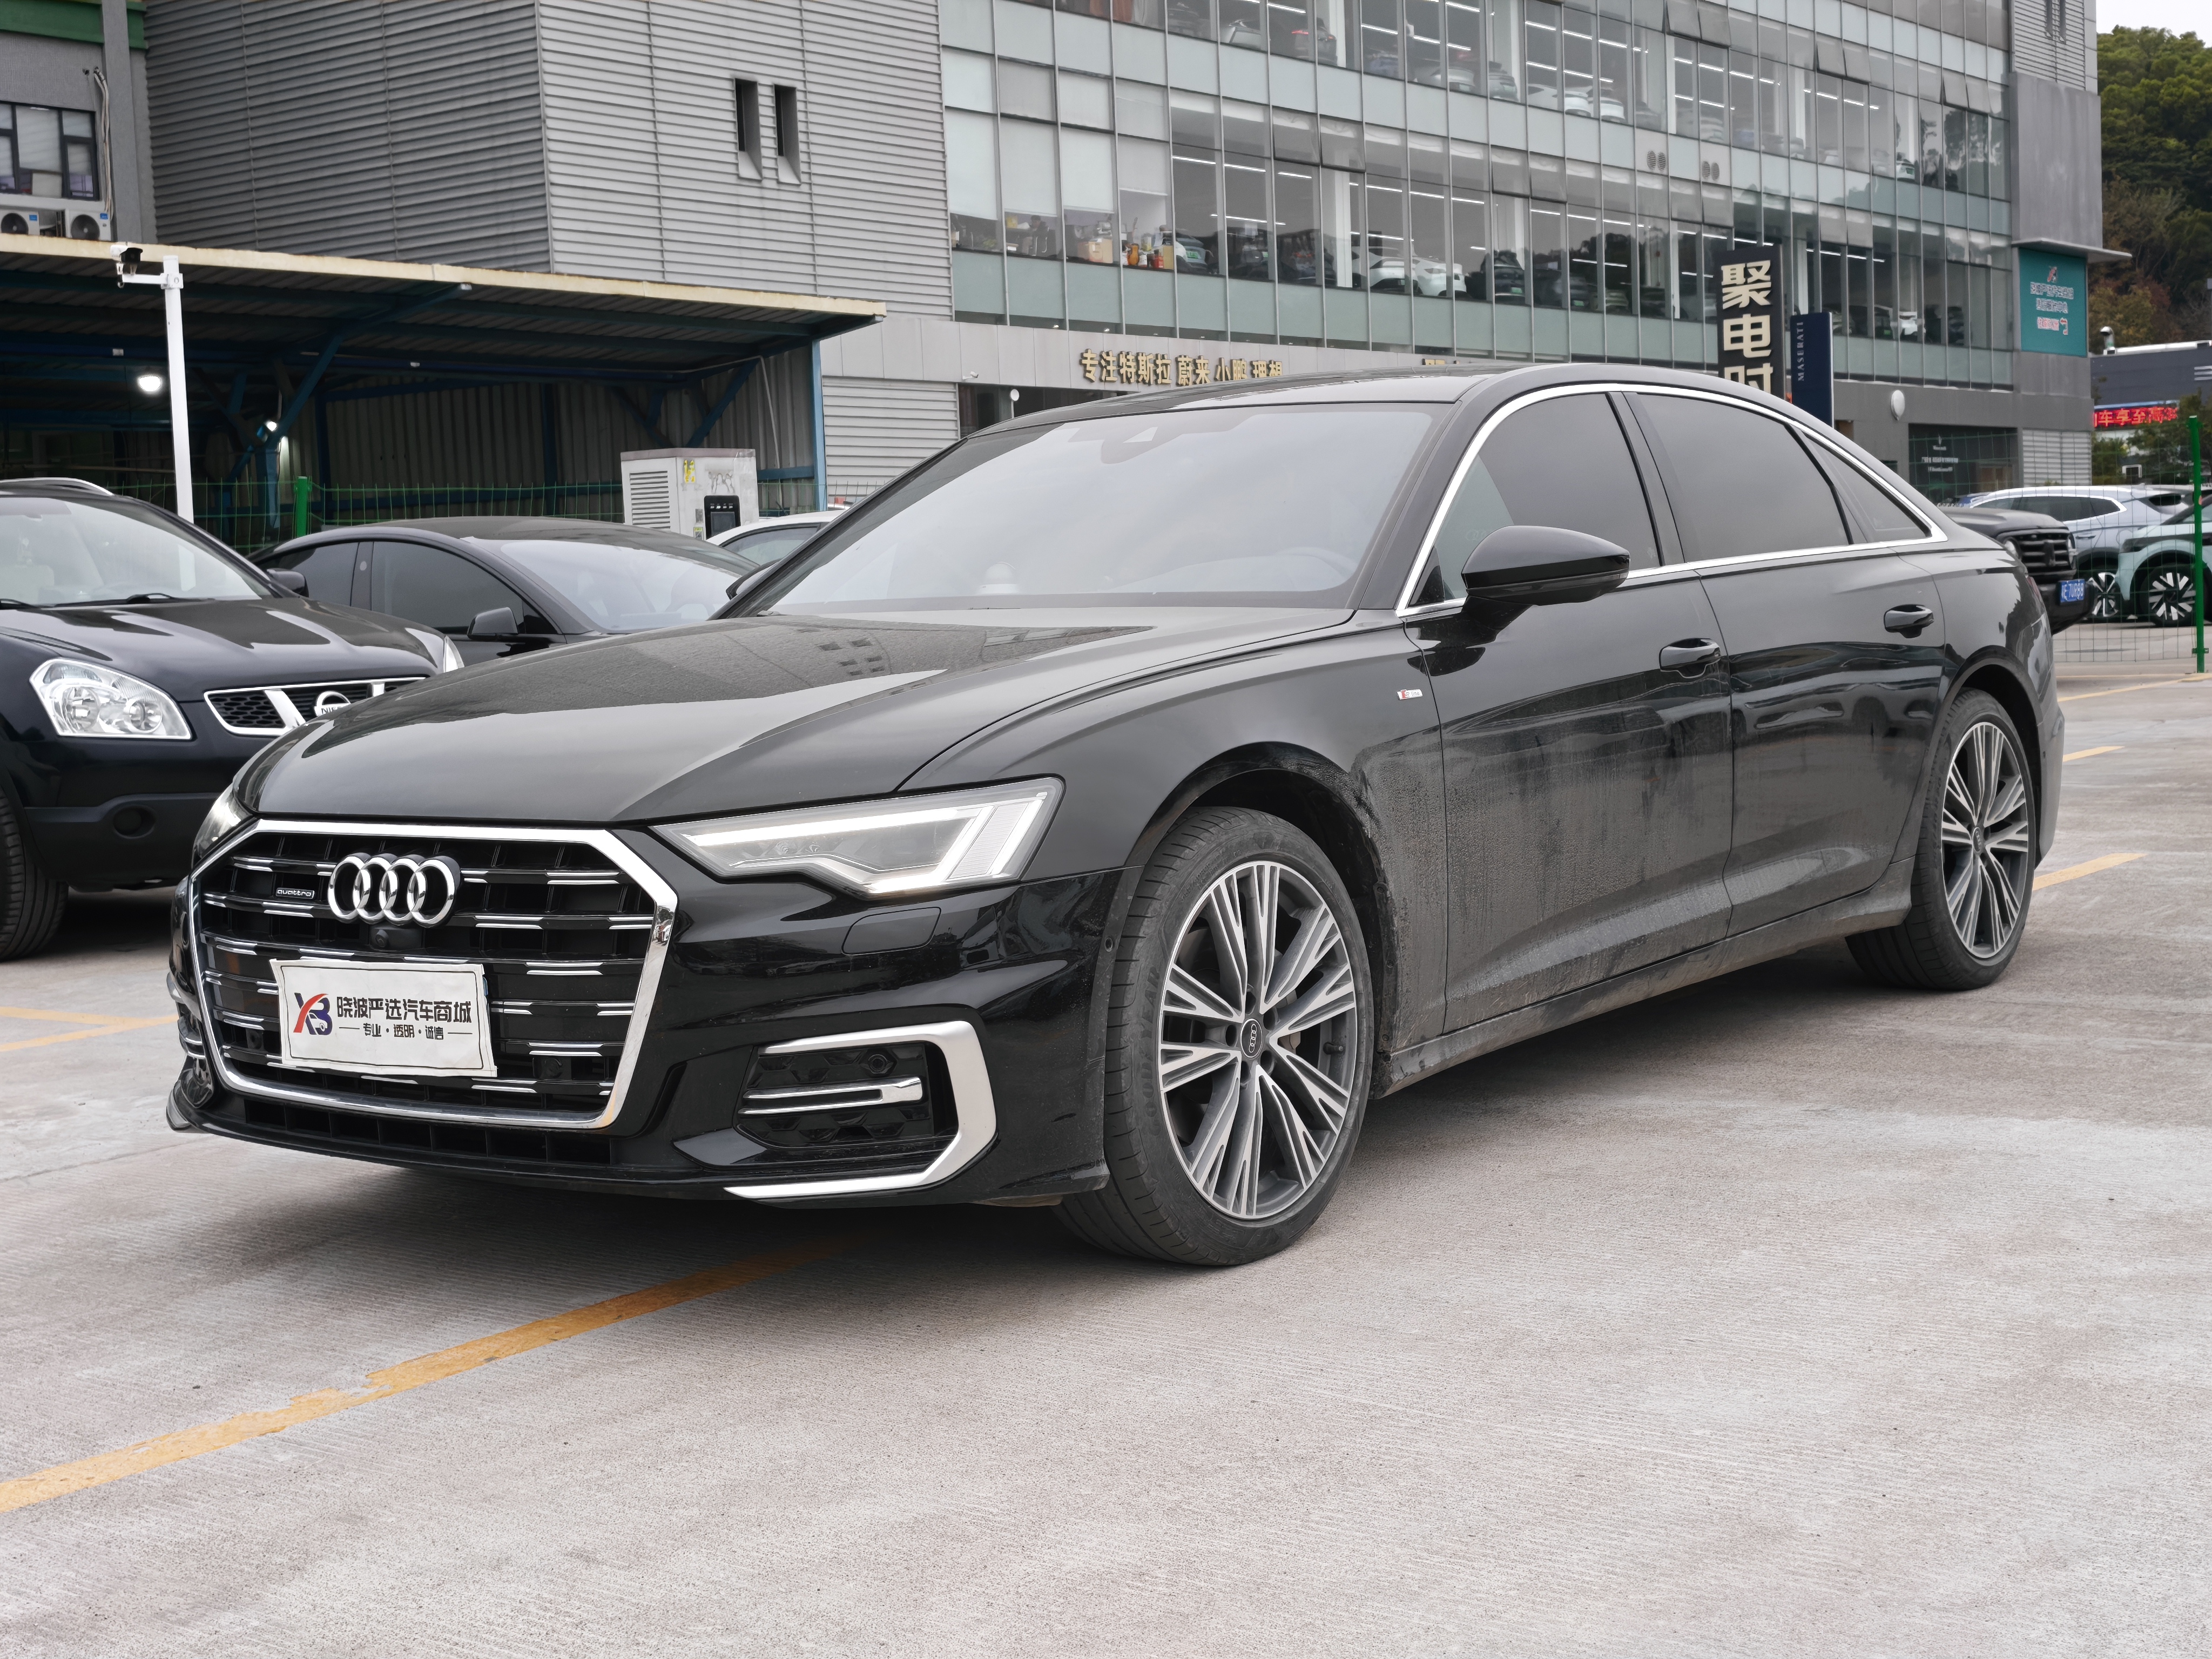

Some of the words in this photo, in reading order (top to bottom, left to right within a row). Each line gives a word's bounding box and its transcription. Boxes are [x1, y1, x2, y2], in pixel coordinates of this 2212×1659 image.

[1080, 348, 1172, 386] 专注特斯拉
[1176, 354, 1211, 386] 蔚来
[336, 996, 472, 1023] 晓波严选汽车商城
